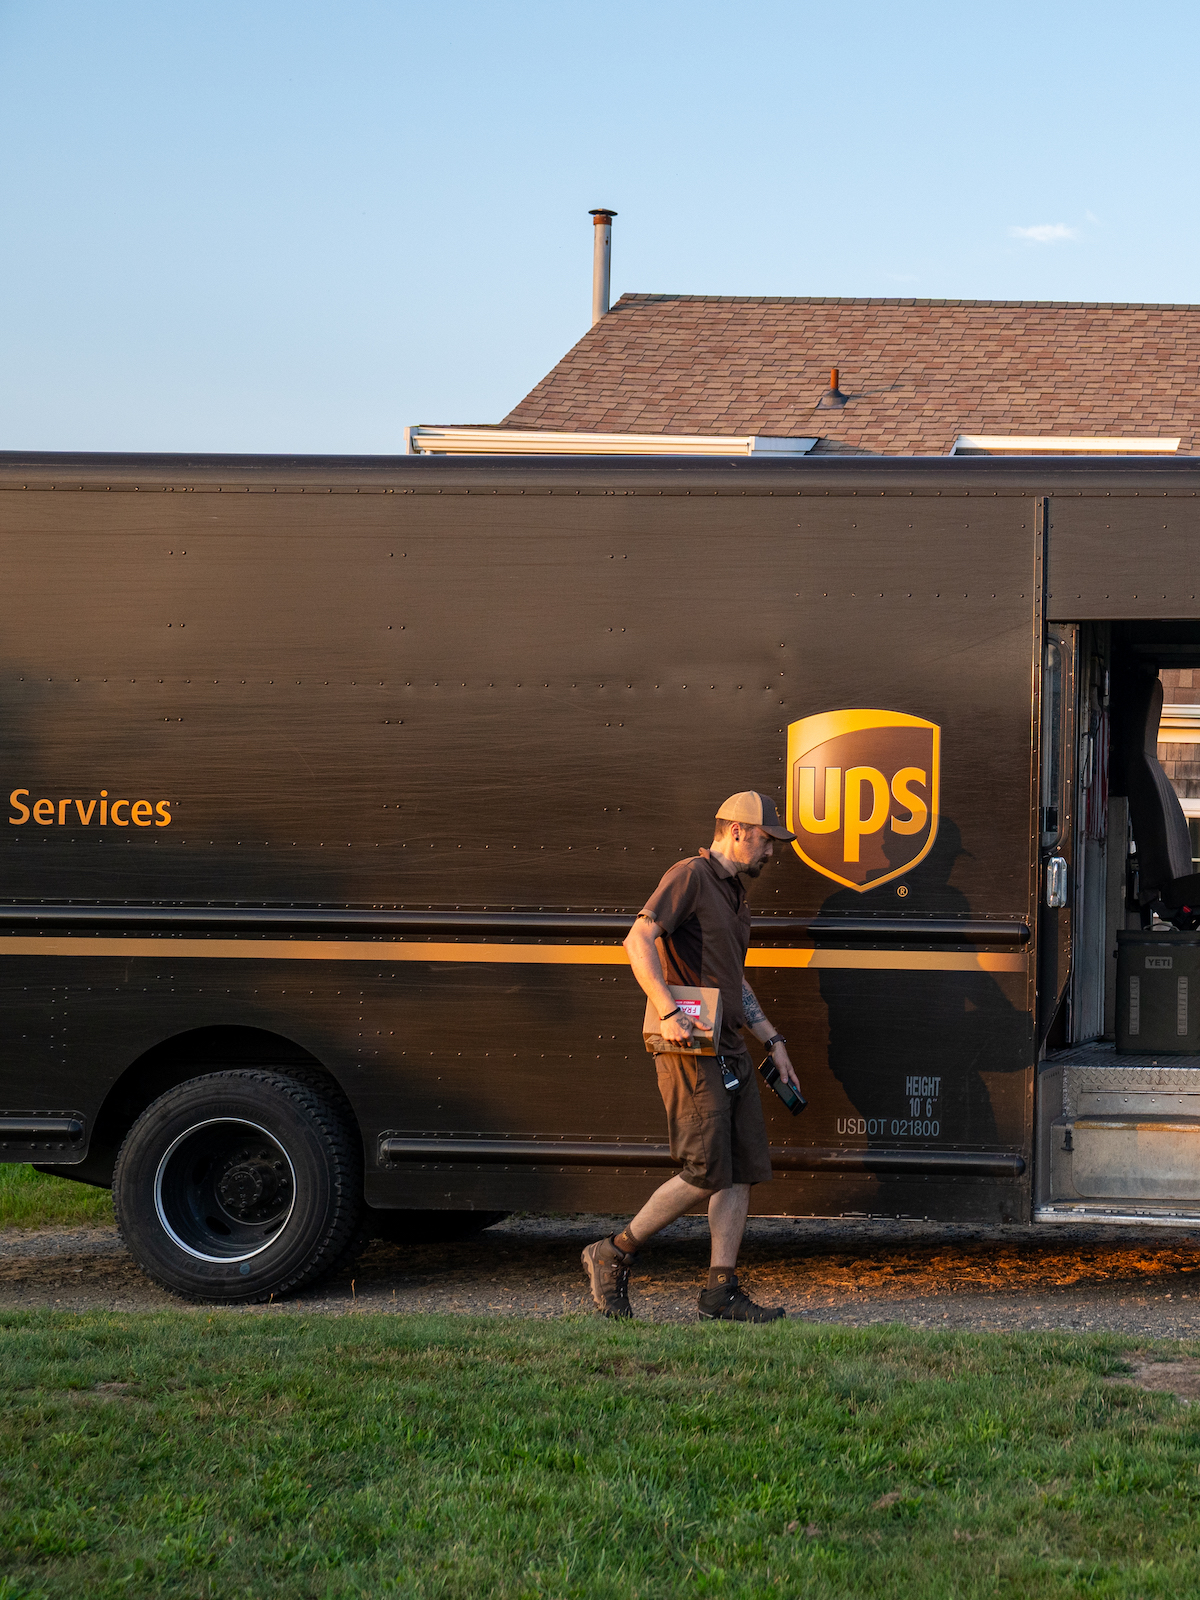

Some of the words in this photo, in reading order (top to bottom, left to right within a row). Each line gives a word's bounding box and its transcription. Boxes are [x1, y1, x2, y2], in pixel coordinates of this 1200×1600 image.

[8, 788, 172, 827] Services
[799, 766, 928, 863] ups
[1147, 959, 1171, 967] YETI
[905, 1076, 941, 1096] HEIGHT
[837, 1118, 887, 1135] USDOT
[890, 1119, 940, 1136] 021800
